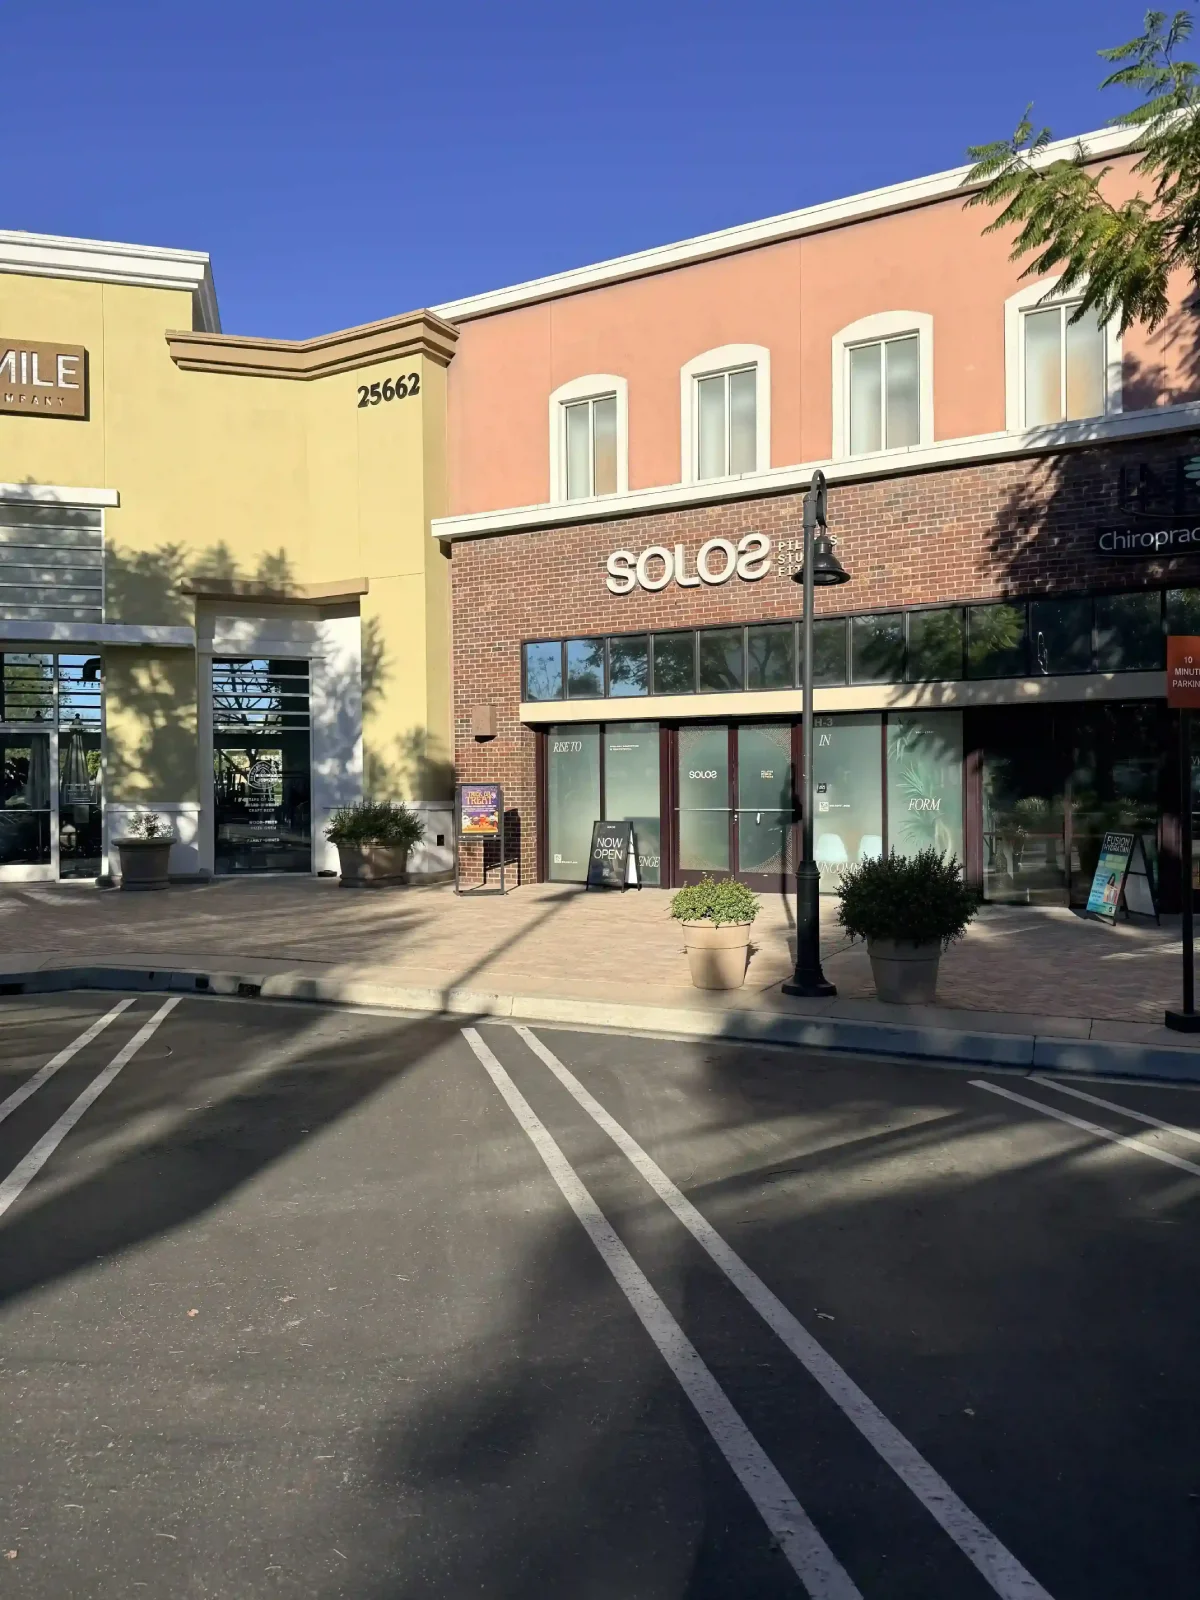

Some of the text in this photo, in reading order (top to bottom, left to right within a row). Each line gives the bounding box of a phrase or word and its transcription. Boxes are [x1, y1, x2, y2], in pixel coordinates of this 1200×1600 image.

[357, 372, 421, 408] 25662
[778, 535, 838, 552] PILS
[606, 532, 772, 595] SOLOS
[1183, 656, 1193, 664] 10
[818, 734, 832, 747] IN
[553, 741, 582, 753] RISE TO
[689, 770, 718, 779] SOLOS
[465, 796, 492, 805] TREAT
[908, 798, 941, 811] FORM
[596, 837, 624, 848] NOW
[1106, 835, 1131, 847] FUSION
[593, 848, 623, 860] OPEN
